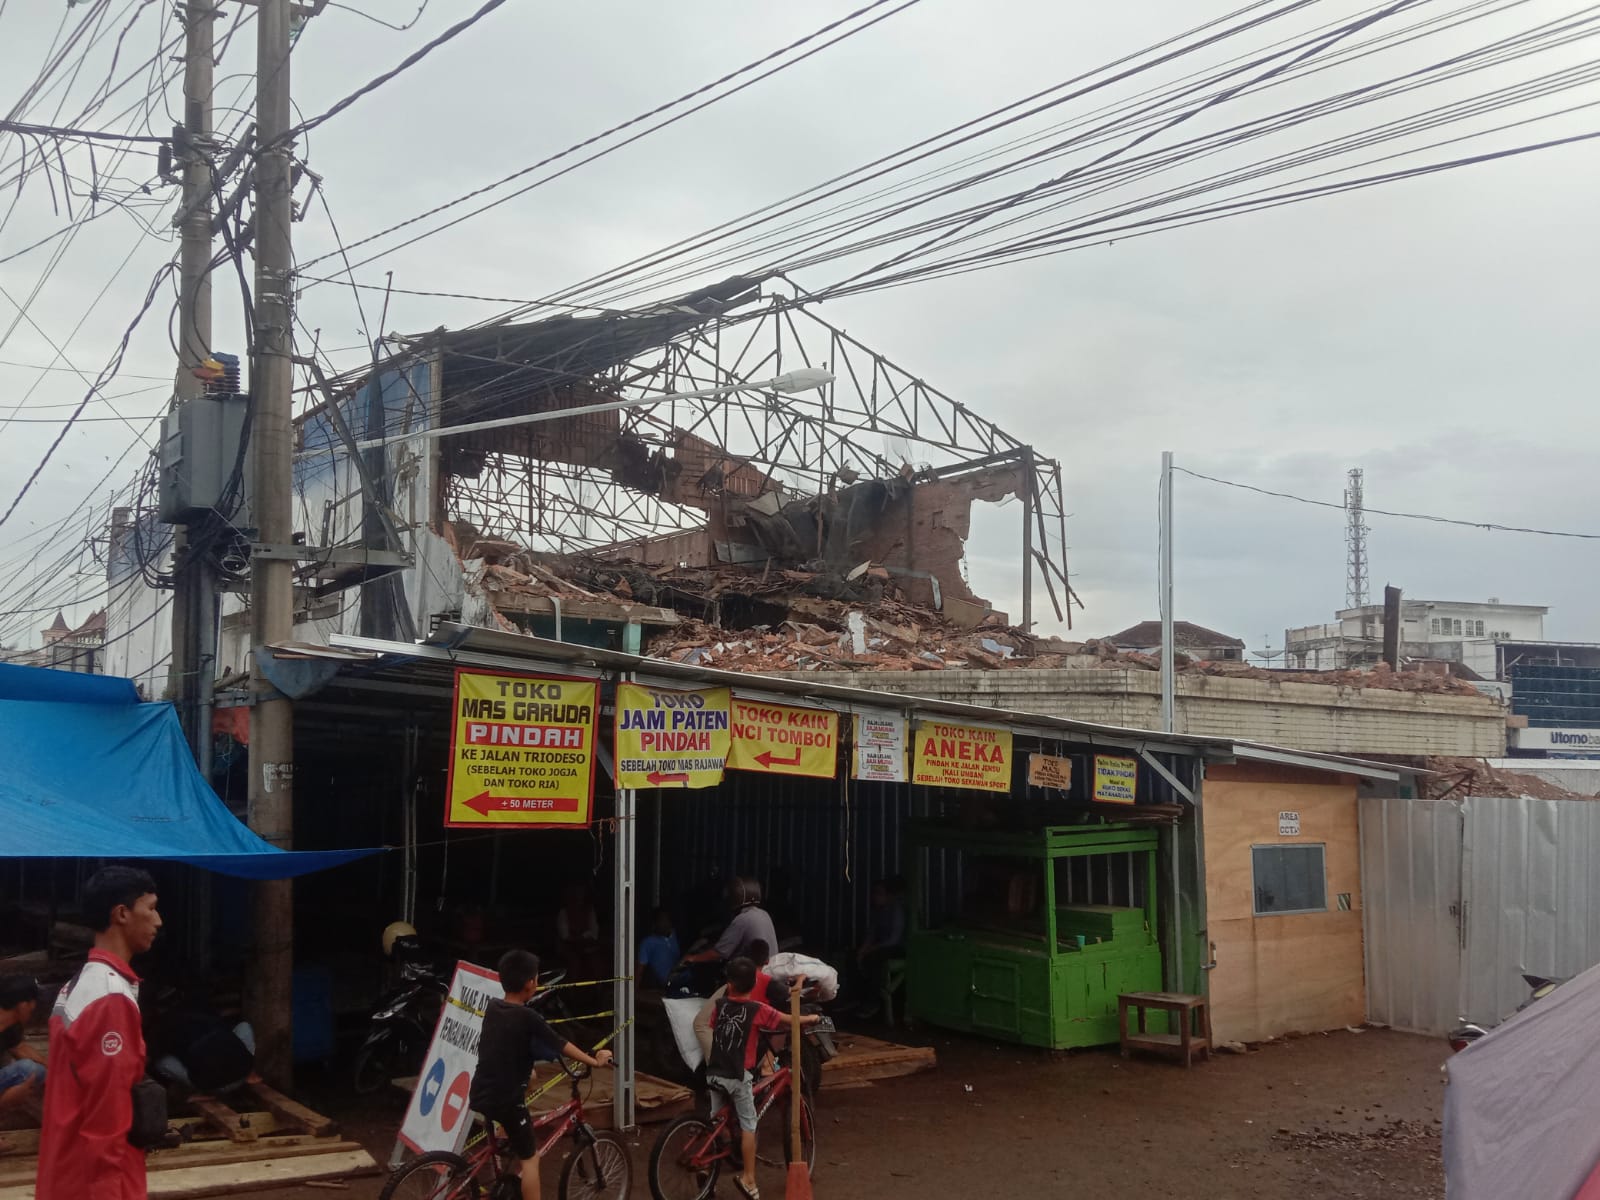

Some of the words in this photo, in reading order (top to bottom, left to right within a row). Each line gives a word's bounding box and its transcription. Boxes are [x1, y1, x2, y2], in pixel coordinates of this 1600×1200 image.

[496, 681, 562, 700] TOKO
[649, 691, 705, 709] TOKO
[462, 698, 506, 720] MAS
[513, 702, 591, 724] GARUDA
[737, 705, 783, 725] TOKO
[787, 712, 828, 730] KAIN
[620, 710, 665, 730] JAM
[672, 710, 728, 730] PATEN
[470, 724, 580, 747] PINDAH
[641, 732, 711, 751] PINDAH
[934, 725, 965, 739] TOKO
[968, 729, 996, 742] KAIN
[461, 749, 477, 760] KE
[480, 750, 520, 762] JALAN
[524, 752, 585, 764] TRIODESO
[923, 737, 1005, 764] ANEKA
[467, 765, 515, 775] (SEBELAH
[519, 767, 546, 776] TOKO
[549, 767, 577, 777] JOGJA
[621, 760, 657, 772] SEBELAH
[659, 760, 676, 771] TOKO
[678, 760, 693, 771] MAS
[926, 759, 949, 767] PINDAH
[961, 762, 980, 771] JALAN
[483, 779, 504, 787] DAN
[508, 779, 536, 788] TOKO
[538, 780, 560, 790] RIA)
[917, 774, 942, 783] SEBELAH
[944, 777, 960, 785] TOKO
[989, 781, 1007, 789] SPORT
[510, 800, 520, 808] 50
[522, 800, 554, 809] METER
[1280, 812, 1298, 821] AREA
[1280, 826, 1299, 834] CCTV
